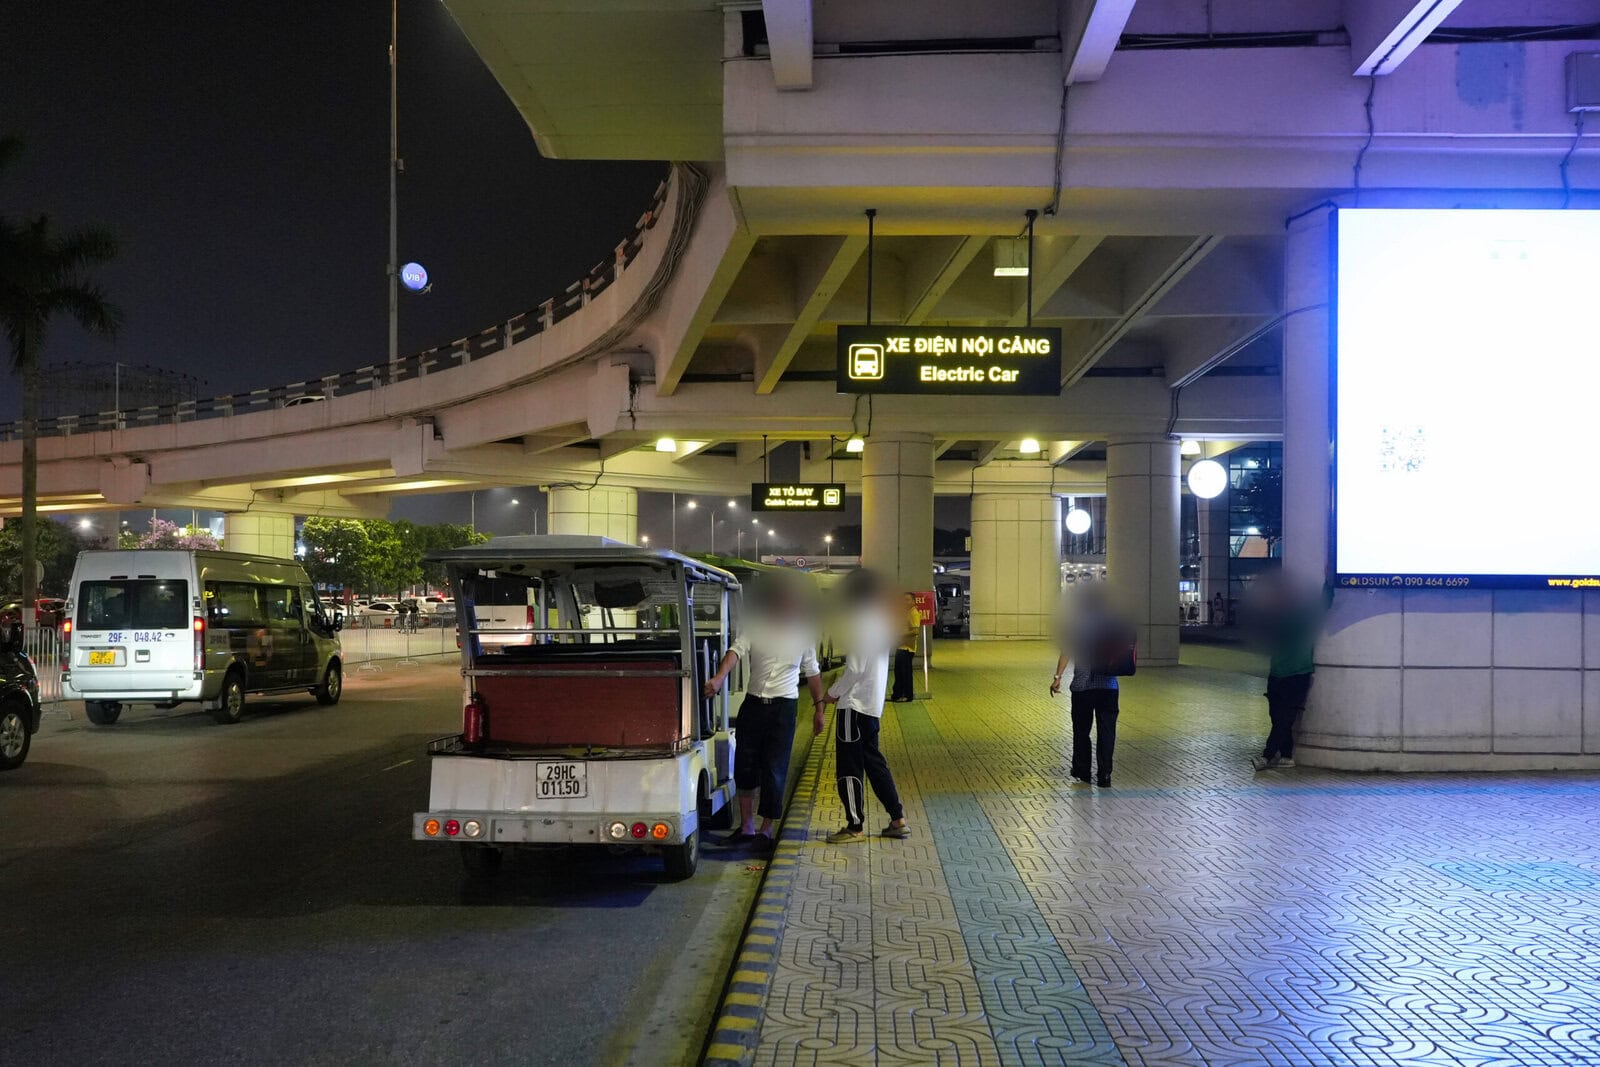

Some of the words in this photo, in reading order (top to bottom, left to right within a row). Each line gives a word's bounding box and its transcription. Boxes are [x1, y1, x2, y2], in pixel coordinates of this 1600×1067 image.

[406, 273, 420, 281] VIB
[886, 337, 910, 353] XE
[914, 335, 957, 356] ĐIỆN
[962, 335, 993, 357] NỘI
[998, 335, 1050, 354] CẢNG
[920, 366, 984, 382] Electric
[988, 366, 1019, 382] Car
[769, 487, 781, 496] XE
[796, 488, 814, 496] BAY
[764, 498, 786, 506] Cabin
[786, 498, 805, 506] Crew
[805, 498, 819, 506] Car
[1341, 576, 1390, 586] GOLDSUN
[1404, 577, 1422, 586] 090
[1425, 576, 1443, 586] 464
[1445, 576, 1469, 587] 6699
[134, 631, 162, 642] 048.42
[546, 765, 576, 780] 29HC
[542, 780, 580, 796] 011.50
